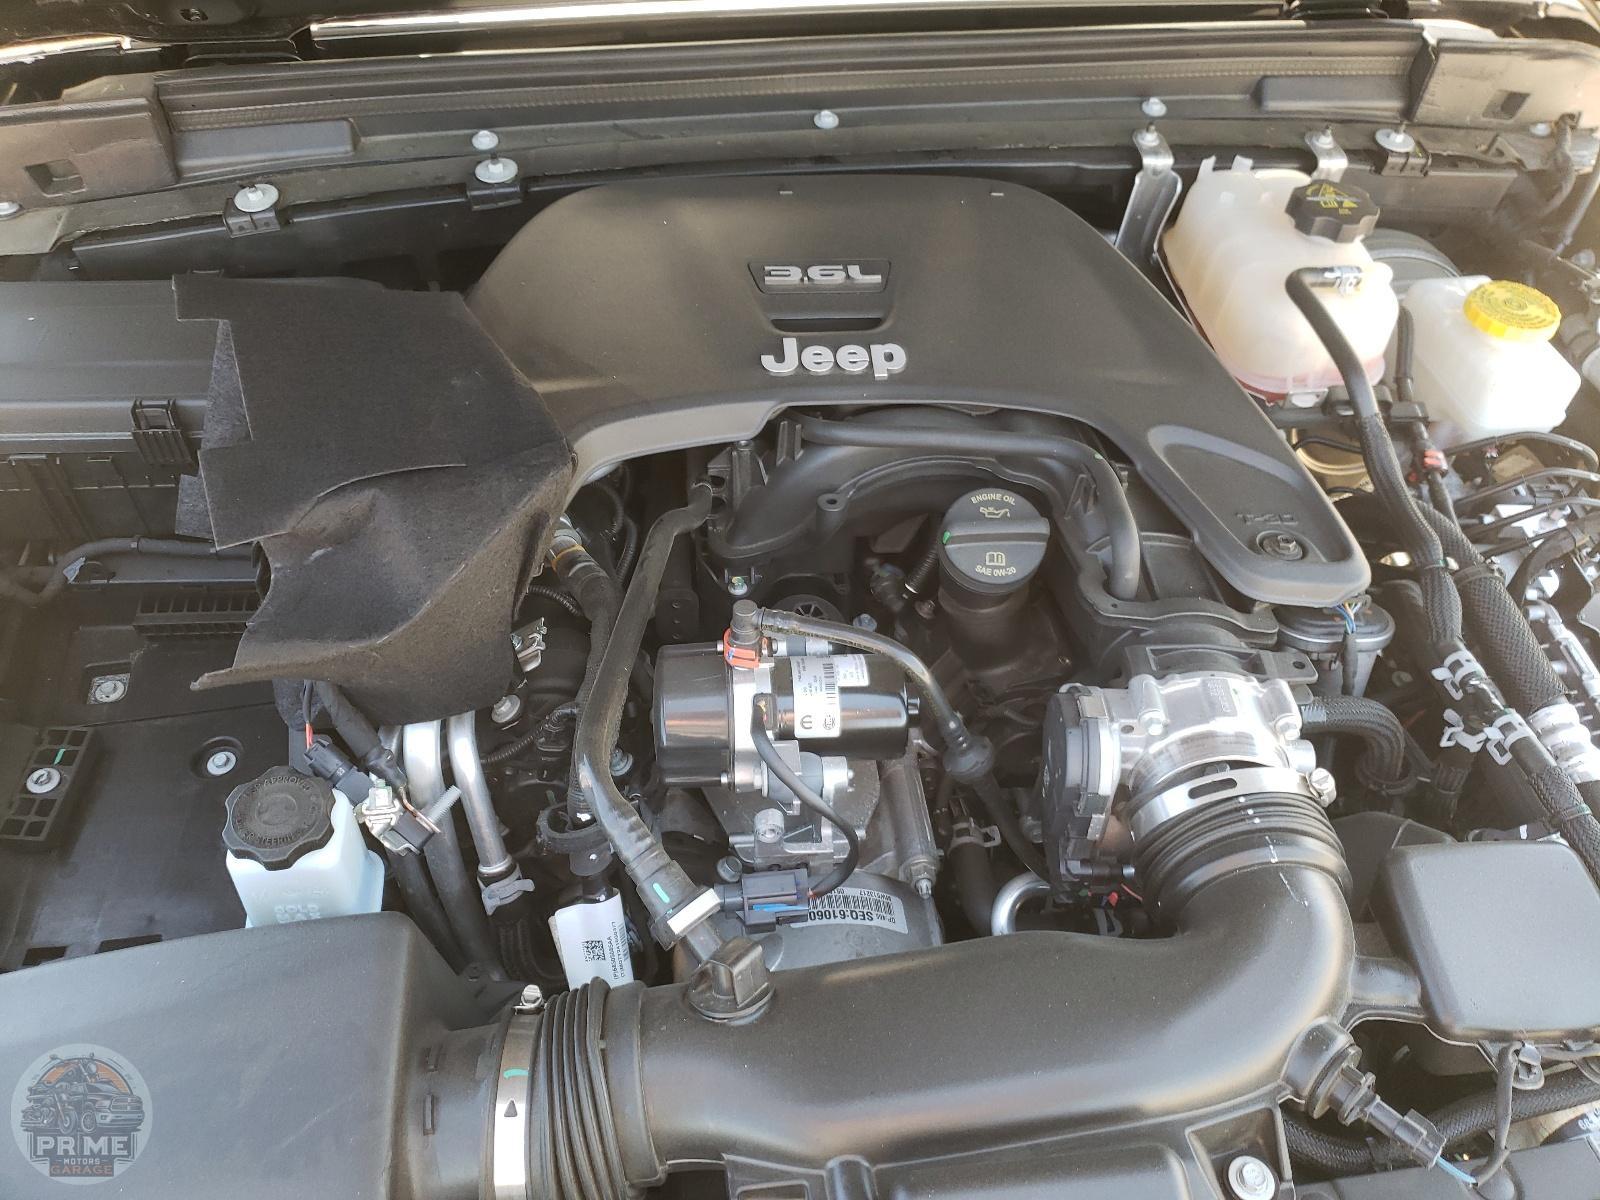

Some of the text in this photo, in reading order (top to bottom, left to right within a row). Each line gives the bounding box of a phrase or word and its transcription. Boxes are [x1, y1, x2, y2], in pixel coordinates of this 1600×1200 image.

[764, 265, 882, 284] 3.6L
[760, 337, 907, 380] Jeep
[971, 493, 1016, 505] ENGINE OIL
[975, 565, 992, 576] SAE
